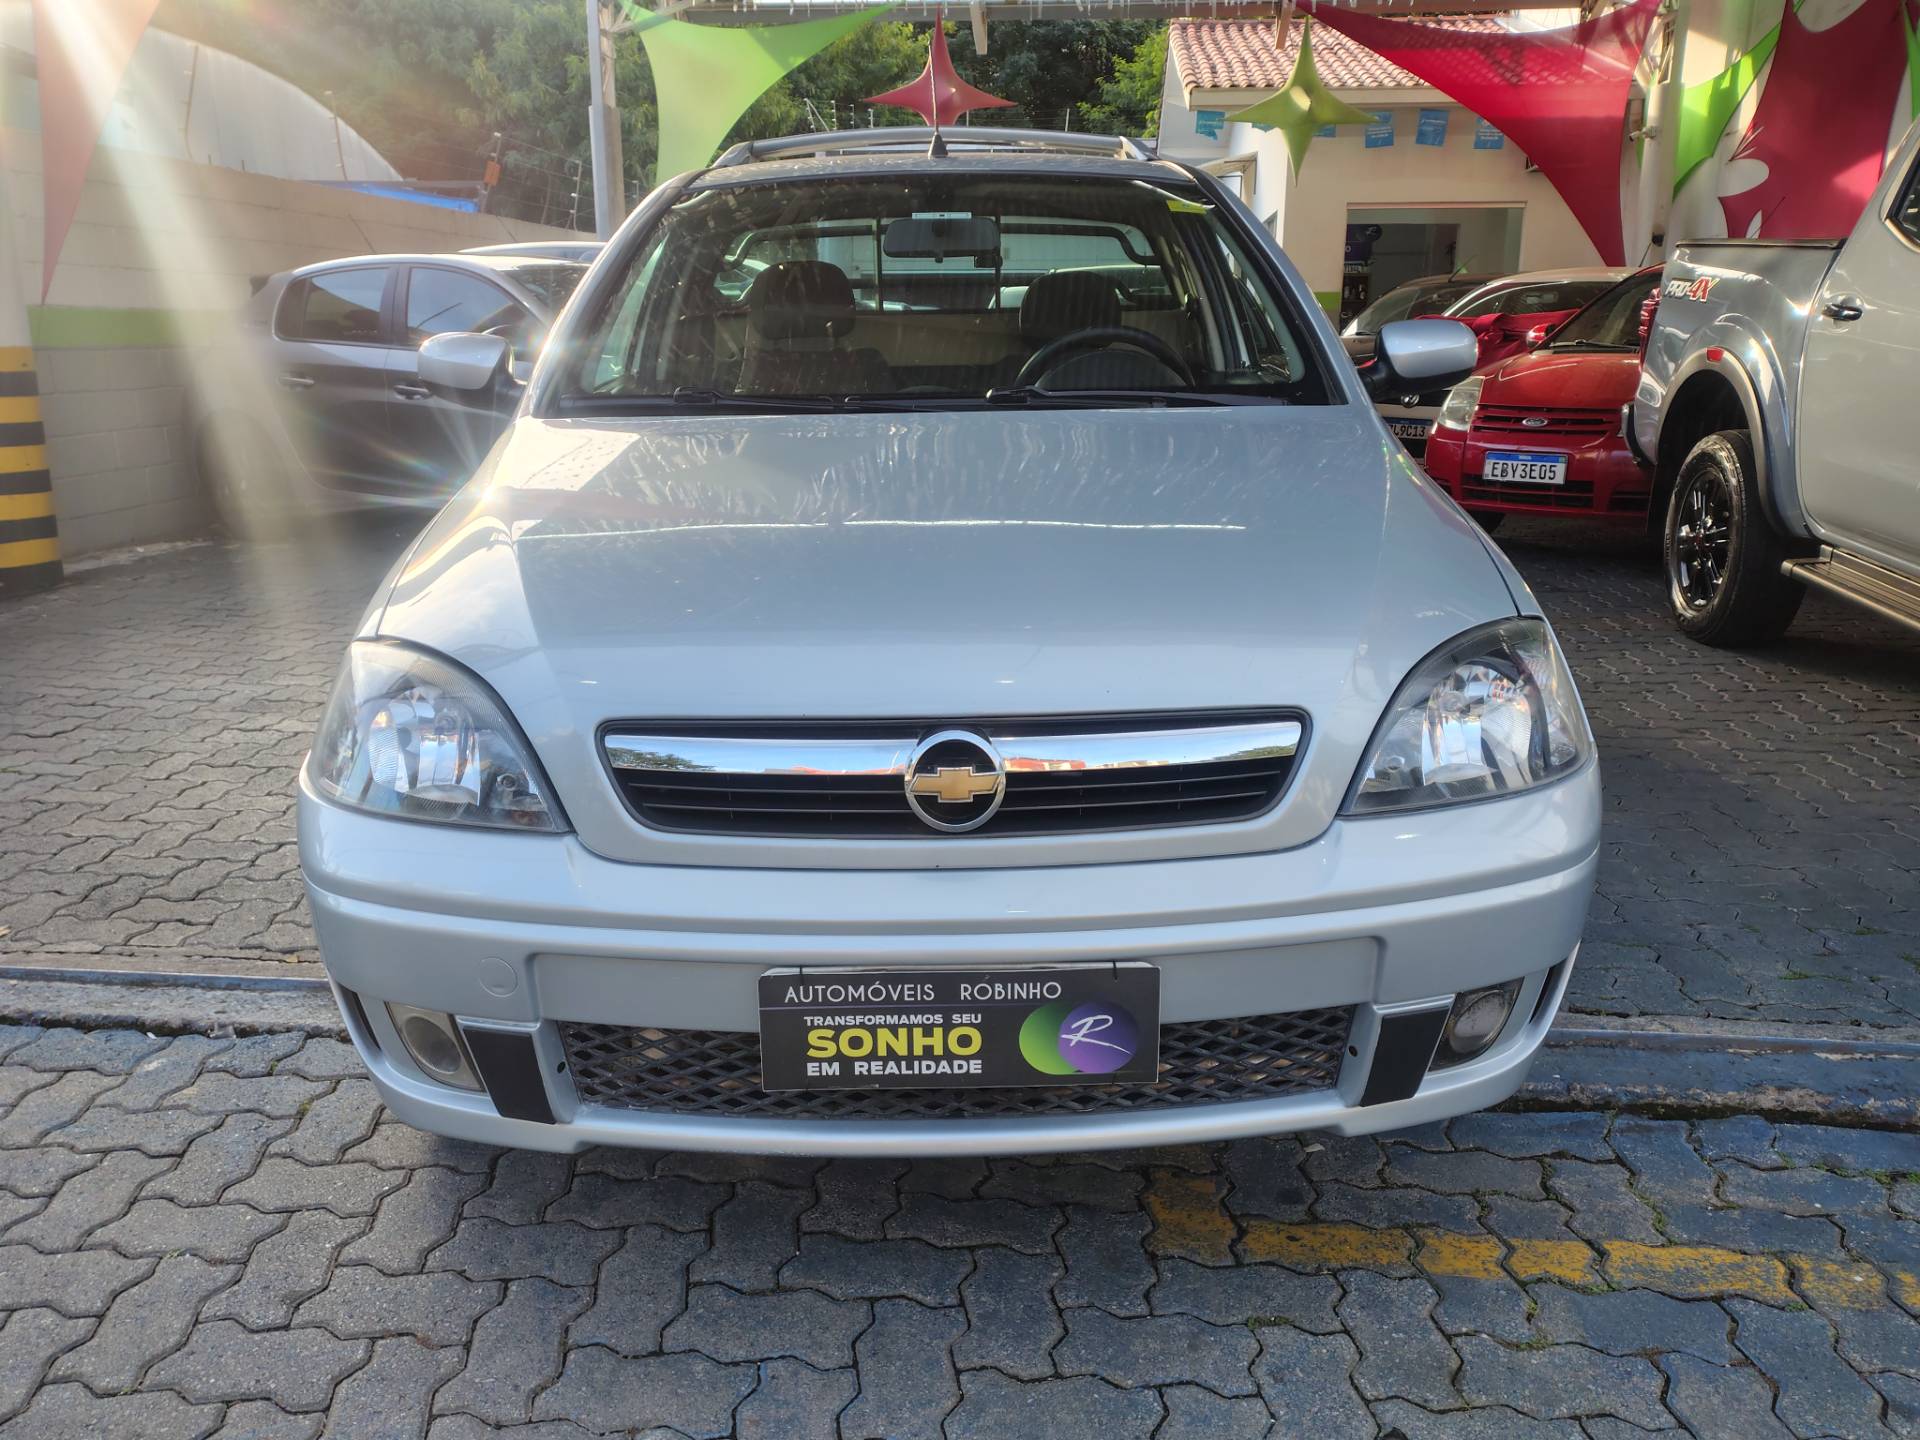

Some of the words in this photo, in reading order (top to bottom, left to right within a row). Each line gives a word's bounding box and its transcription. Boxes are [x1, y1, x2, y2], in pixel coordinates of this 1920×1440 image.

[1390, 423, 1426, 437] L9C13
[1491, 461, 1557, 480] EBY3E05
[784, 980, 935, 1003] AUTOMÓVEIS
[803, 1013, 944, 1027] TRANSFORMAMOS
[951, 1013, 982, 1024] SEU
[806, 1026, 983, 1058] SONHO
[806, 1061, 840, 1076] EM
[854, 1059, 983, 1076] REALIDADE
